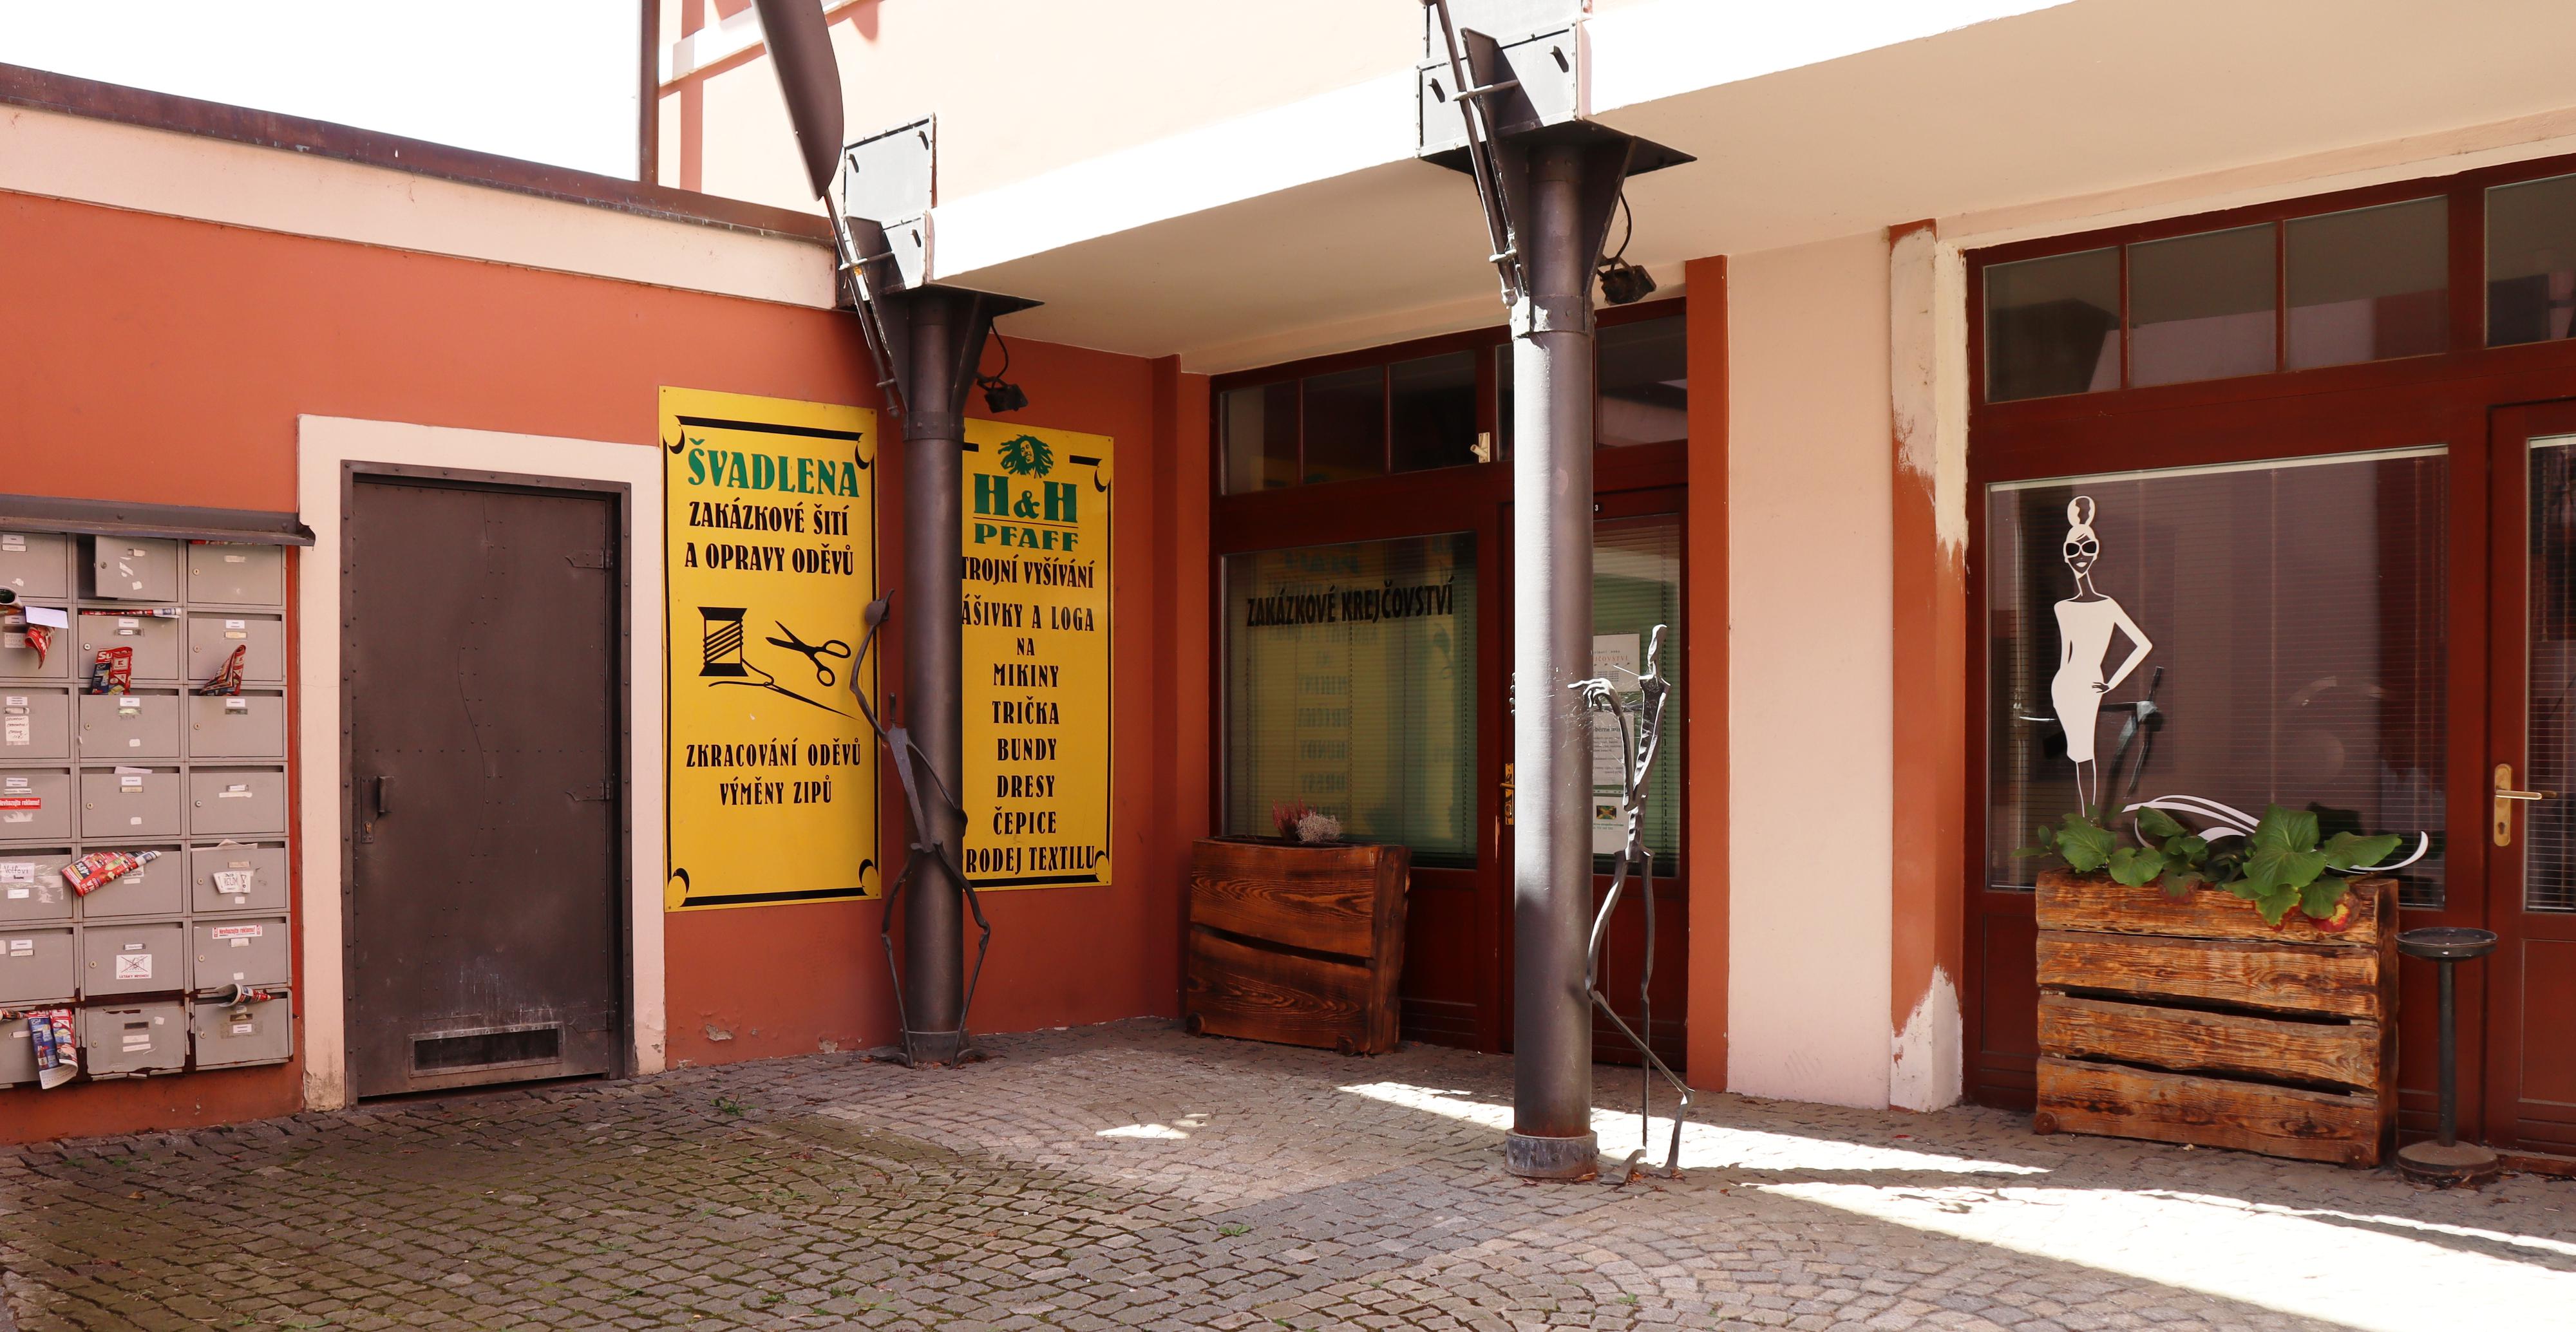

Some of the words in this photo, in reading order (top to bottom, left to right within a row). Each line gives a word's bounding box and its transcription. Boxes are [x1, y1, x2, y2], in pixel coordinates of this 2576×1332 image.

[688, 438, 859, 497] ŠVADLENA
[973, 473, 1077, 523] H&H
[689, 497, 804, 533] ZAKÁZKOVÉ
[813, 503, 849, 536] ŠITÍ
[974, 523, 1078, 552] PFAFF
[685, 542, 697, 567] A
[706, 543, 784, 572] OPRAVY
[792, 543, 853, 576] ODĚVŮ
[962, 554, 1019, 585] TROJNÍ
[1023, 557, 1095, 588] VYŠÍVÁNÍ
[962, 594, 1023, 628] ÁŠIVKY
[1032, 605, 1041, 629] A
[1051, 606, 1094, 631] LOGA
[1247, 585, 1336, 626] ZAKÁZKOVÉ
[1341, 576, 1454, 624] KREJČOVSTVÍ
[1016, 637, 1035, 656] NA
[993, 663, 1059, 688] MIKINY
[992, 695, 1059, 724] TRIČKA
[686, 737, 799, 767] ZKRACOVÁNÍ
[808, 738, 861, 766] ODĚVŮ
[998, 738, 1057, 761] BUNDY
[719, 776, 784, 805] VÝMĚNY
[793, 774, 832, 803] ZIPŮ
[997, 775, 1055, 798] DRESY
[993, 806, 1056, 835] ČEPICE
[966, 847, 1022, 875] RODEJ
[1029, 845, 1095, 872] TEXTILU
